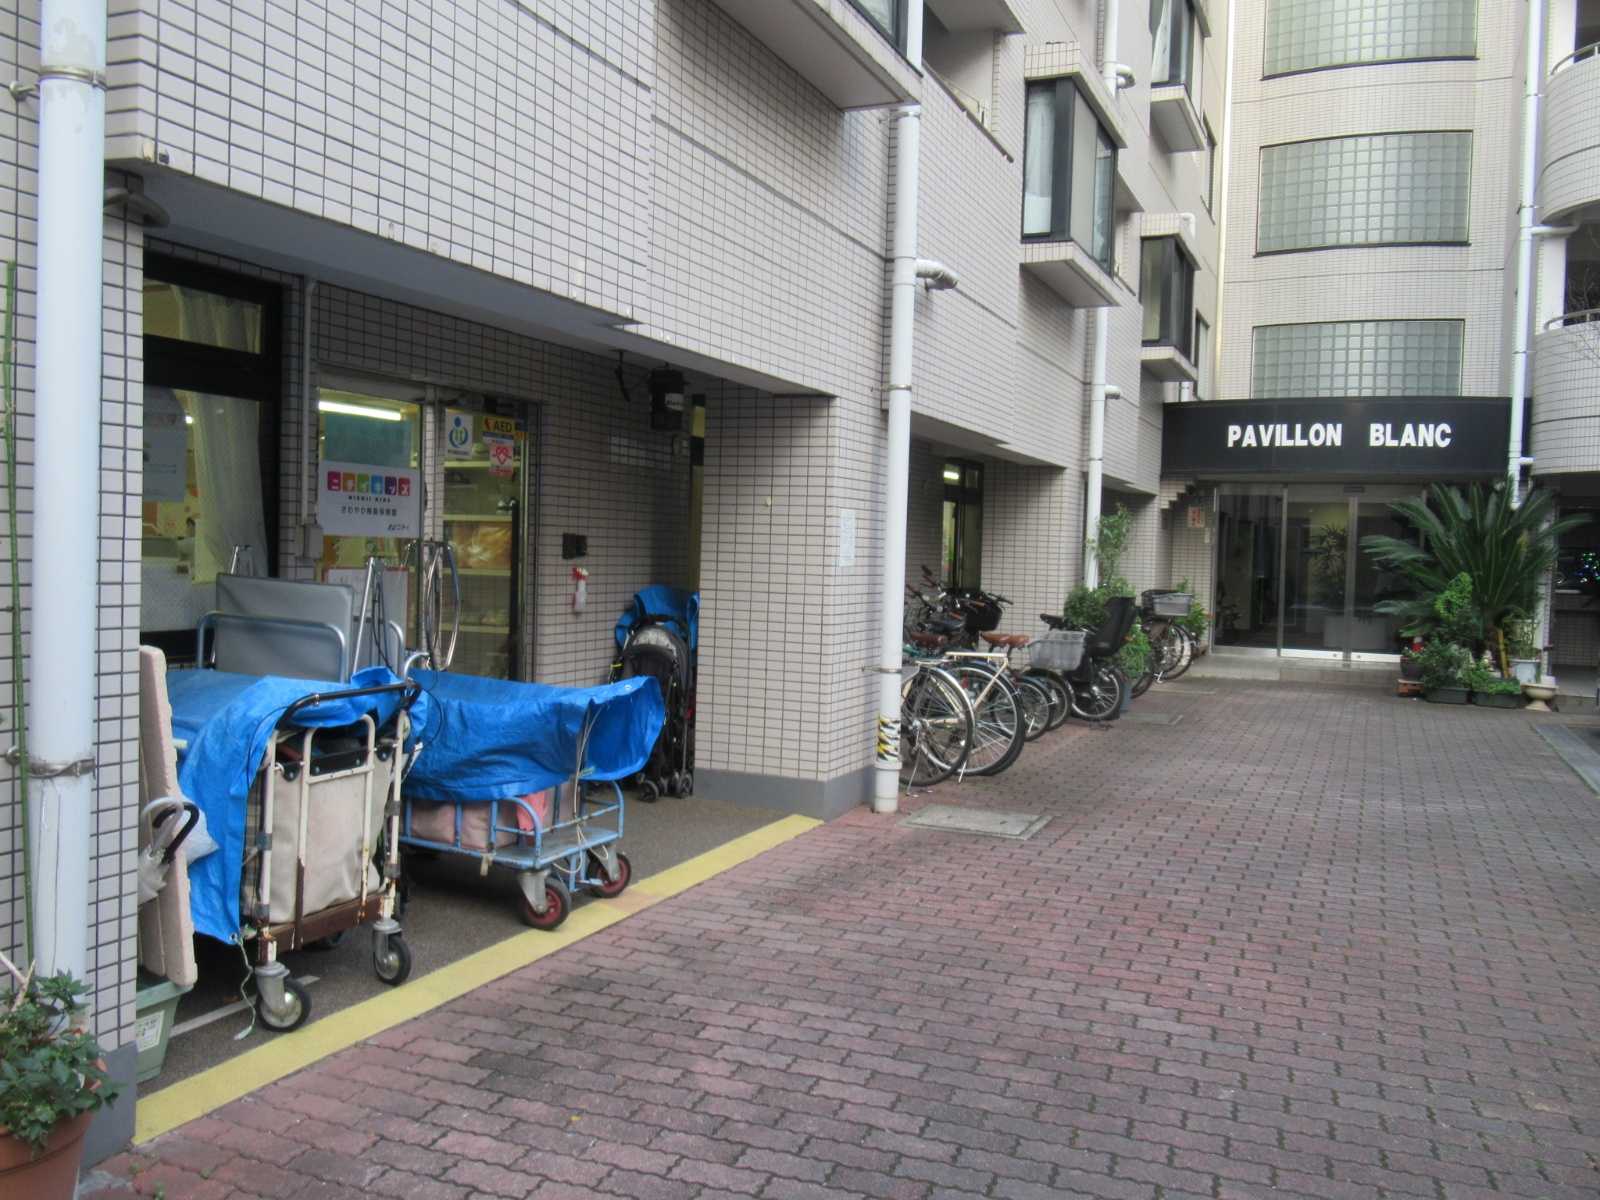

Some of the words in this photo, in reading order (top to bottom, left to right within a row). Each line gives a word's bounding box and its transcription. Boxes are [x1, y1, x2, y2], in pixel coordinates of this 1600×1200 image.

[494, 420, 512, 432] AED
[1227, 423, 1343, 447] PAVILLON
[1369, 423, 1452, 447] BLANC
